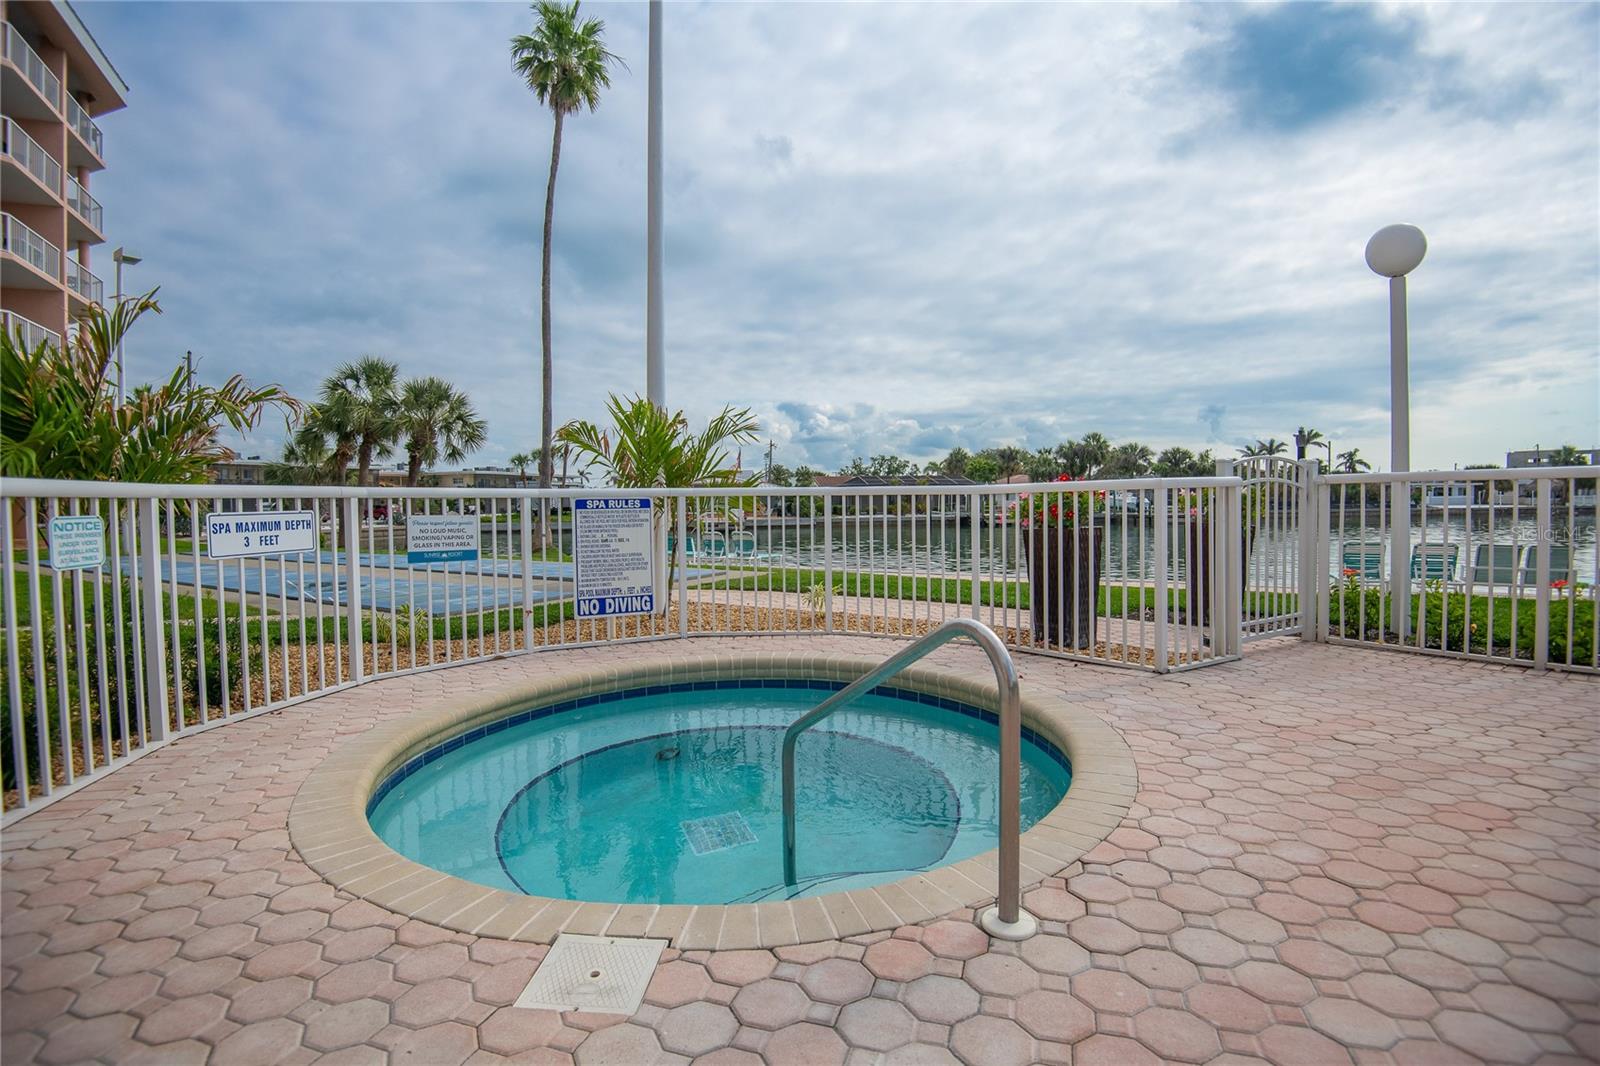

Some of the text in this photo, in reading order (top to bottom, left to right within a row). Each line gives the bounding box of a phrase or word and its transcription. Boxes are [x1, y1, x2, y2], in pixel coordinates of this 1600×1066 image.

[586, 499, 641, 509] SPA RULES
[53, 521, 101, 532] NOTICE
[212, 519, 312, 535] SPA MAXIMUM DEPTH
[244, 534, 280, 548] 3 FEET
[580, 595, 651, 616] NO DIVING
